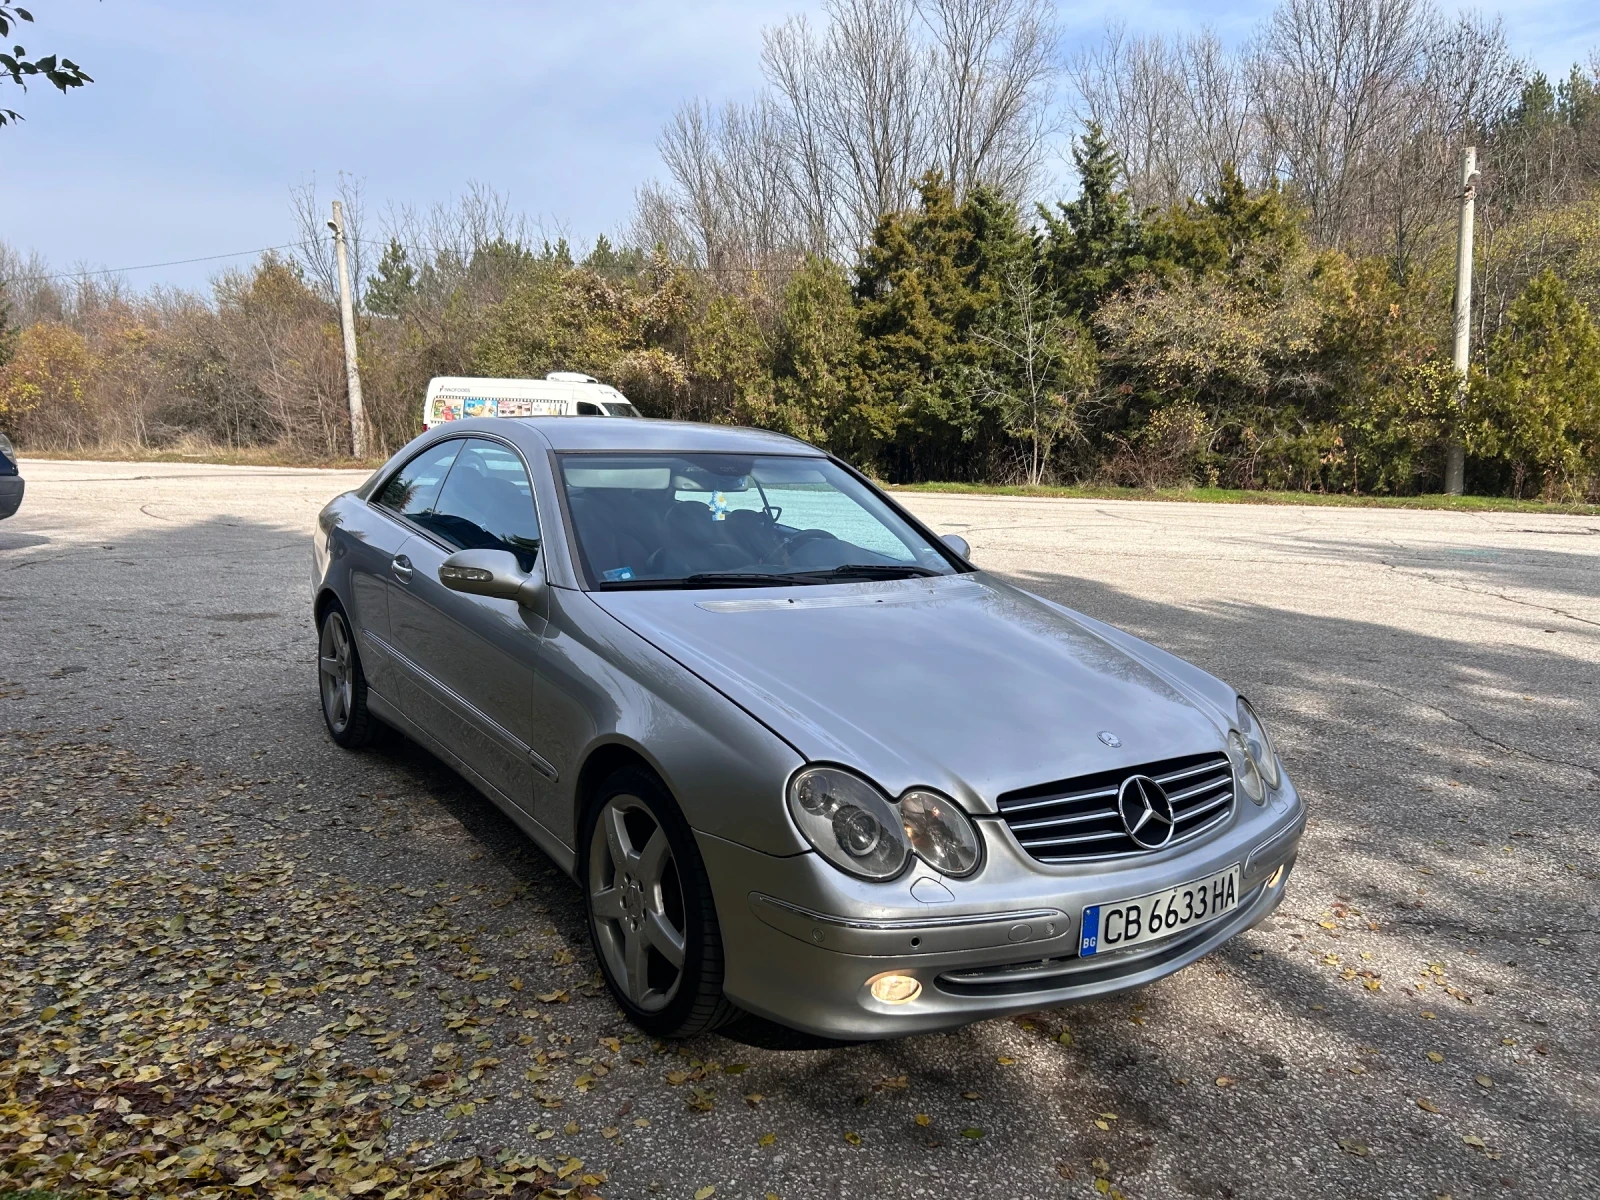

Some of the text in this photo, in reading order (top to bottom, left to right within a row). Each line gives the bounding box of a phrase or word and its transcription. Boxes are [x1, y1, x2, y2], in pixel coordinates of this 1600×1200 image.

[1104, 872, 1235, 944] CB 6633 HA
[1083, 937, 1096, 948] BG
